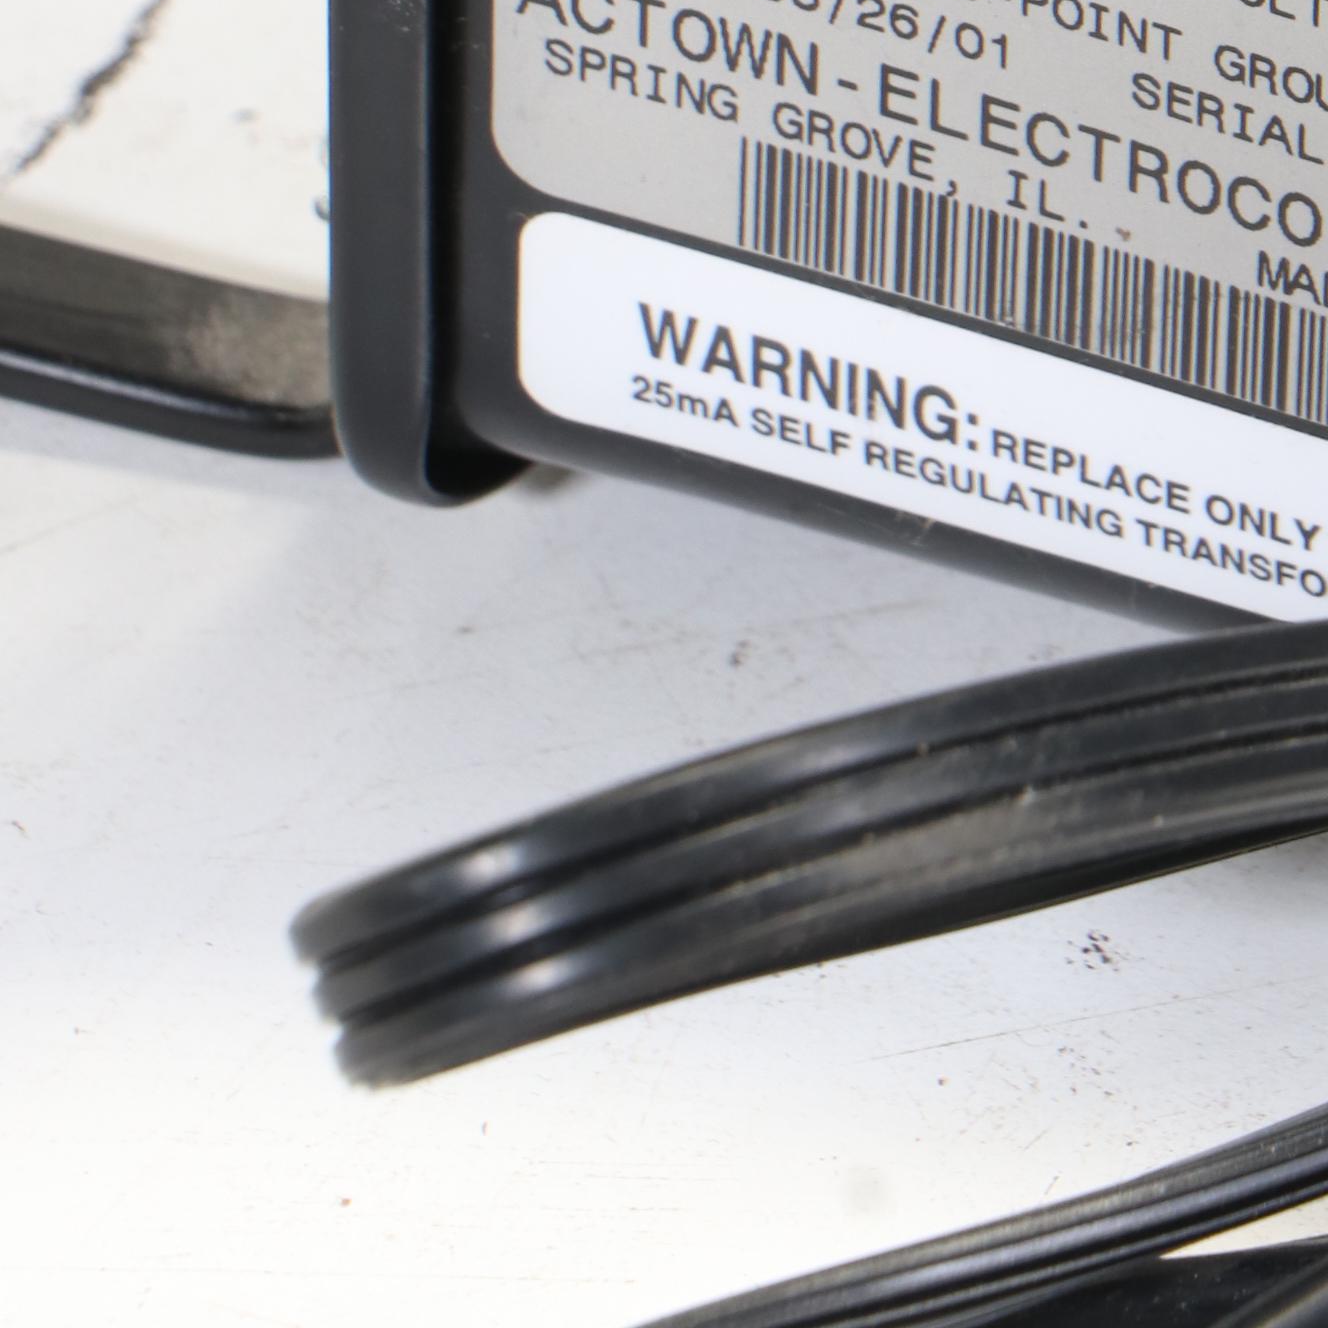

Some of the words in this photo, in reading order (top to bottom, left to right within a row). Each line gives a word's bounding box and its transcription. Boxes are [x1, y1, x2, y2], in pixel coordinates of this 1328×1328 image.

[545, 38, 738, 123] SPRING
[772, 102, 957, 198] GROVE,
[1006, 169, 1088, 229] IL.
[1131, 72, 1324, 165] SERIAL
[632, 375, 739, 427] 25mA
[751, 407, 850, 456] SELF
[864, 440, 1123, 538] REGULATING
[639, 302, 978, 451] WARNING:
[992, 429, 1190, 514] REPLACE
[1205, 494, 1320, 551] ONLY
